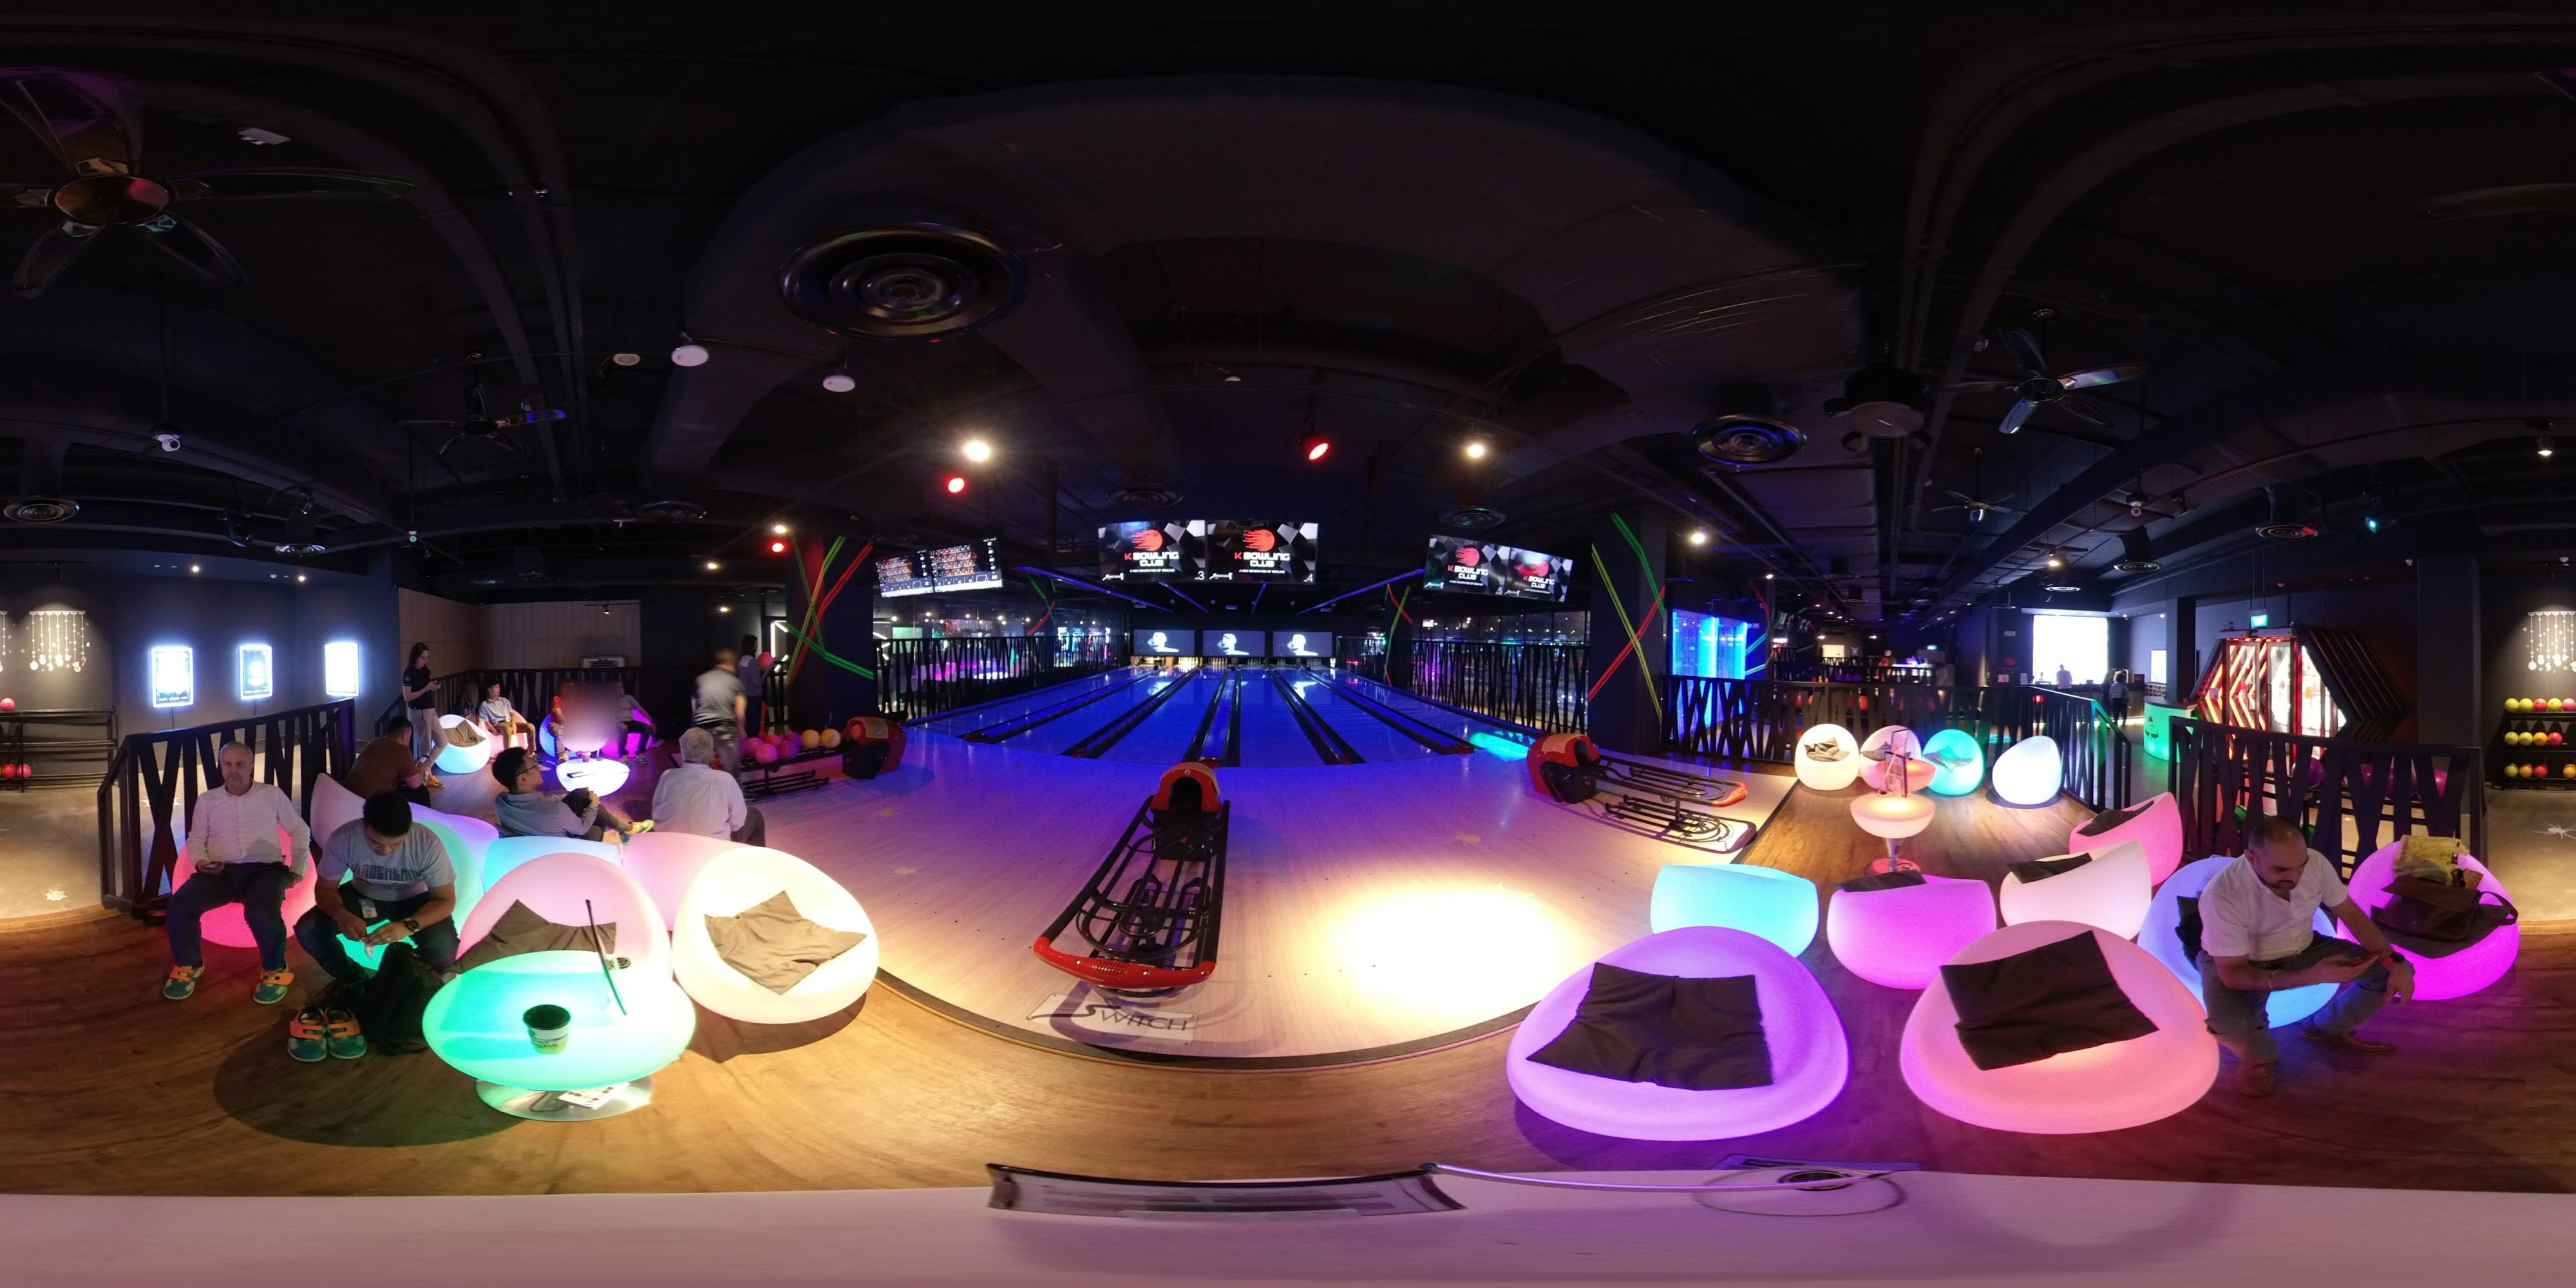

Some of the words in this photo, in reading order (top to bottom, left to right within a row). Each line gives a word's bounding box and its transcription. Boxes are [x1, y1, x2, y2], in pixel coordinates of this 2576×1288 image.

[1133, 551, 1179, 560] BOWLING
[1243, 552, 1290, 561] BOWLING
[1454, 565, 1489, 576] BOWLING
[1197, 571, 1205, 580] 3
[1307, 573, 1313, 582] 4
[1528, 575, 1555, 585] BOWLING
[1026, 1003, 1188, 1032] SWITCH
